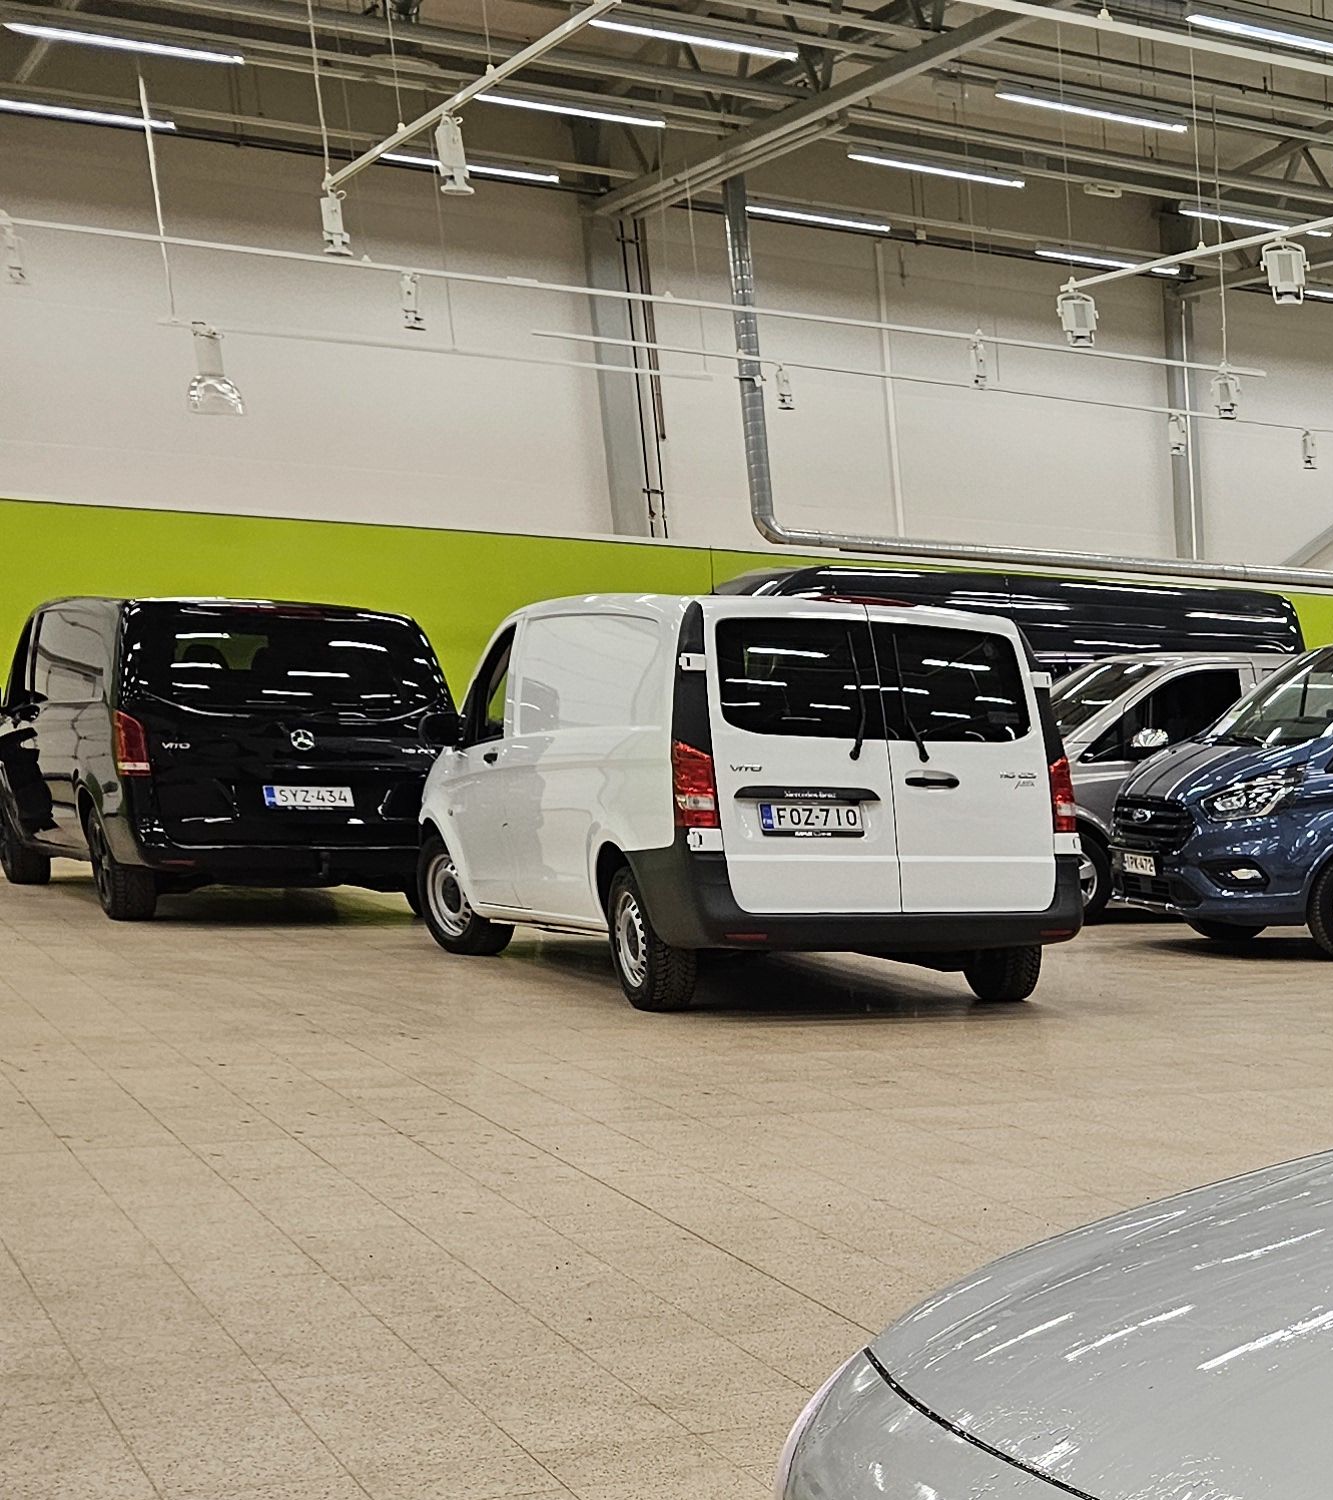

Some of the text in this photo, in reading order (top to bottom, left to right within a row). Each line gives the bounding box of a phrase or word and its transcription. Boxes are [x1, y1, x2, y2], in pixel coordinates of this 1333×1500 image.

[162, 741, 191, 750] VITO
[730, 764, 763, 772] VITO
[279, 789, 348, 804] SYZ-434
[776, 807, 858, 827] FOZ-710
